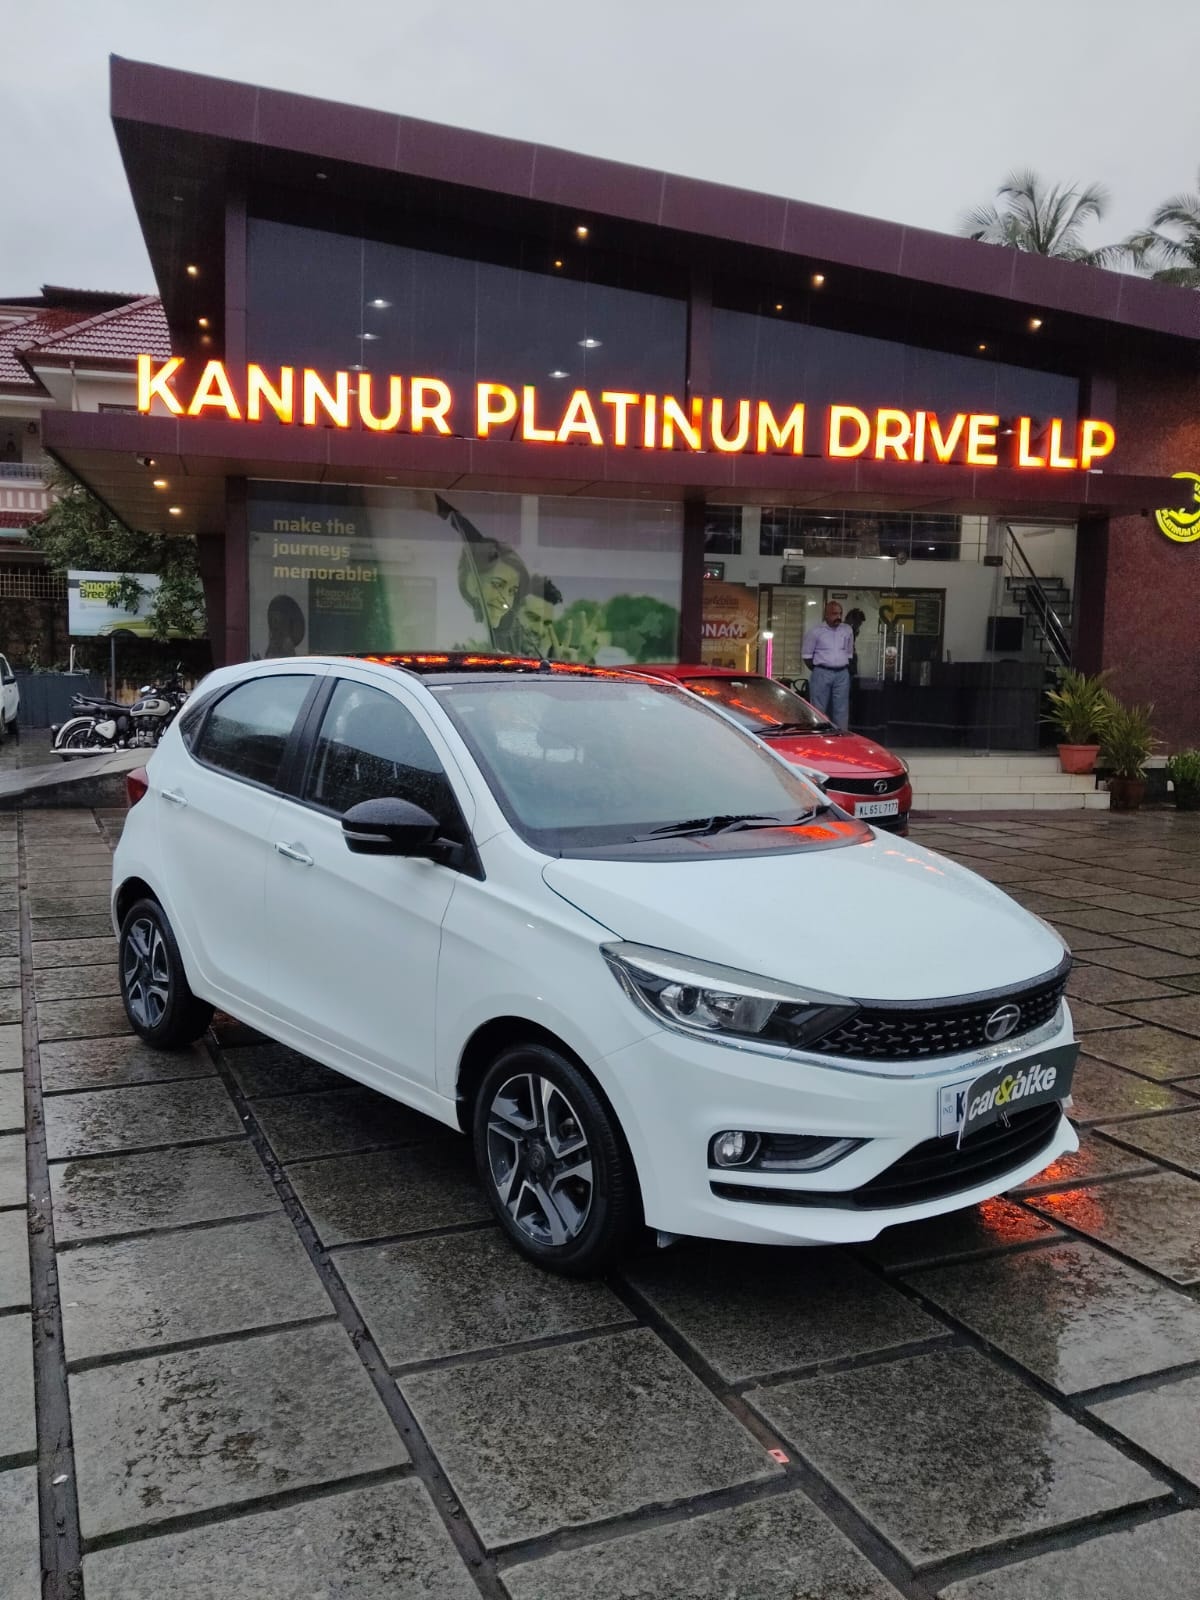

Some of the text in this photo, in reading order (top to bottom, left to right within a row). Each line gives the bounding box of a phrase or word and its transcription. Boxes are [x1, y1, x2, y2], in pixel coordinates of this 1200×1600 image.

[137, 354, 1116, 470] KANNUR PLATINUM DRIVE LLP
[273, 517, 356, 534] make the
[272, 539, 350, 560] journeys
[273, 565, 378, 582] memorable!
[702, 624, 743, 638] NAM
[968, 1064, 1057, 1120] car&bike
